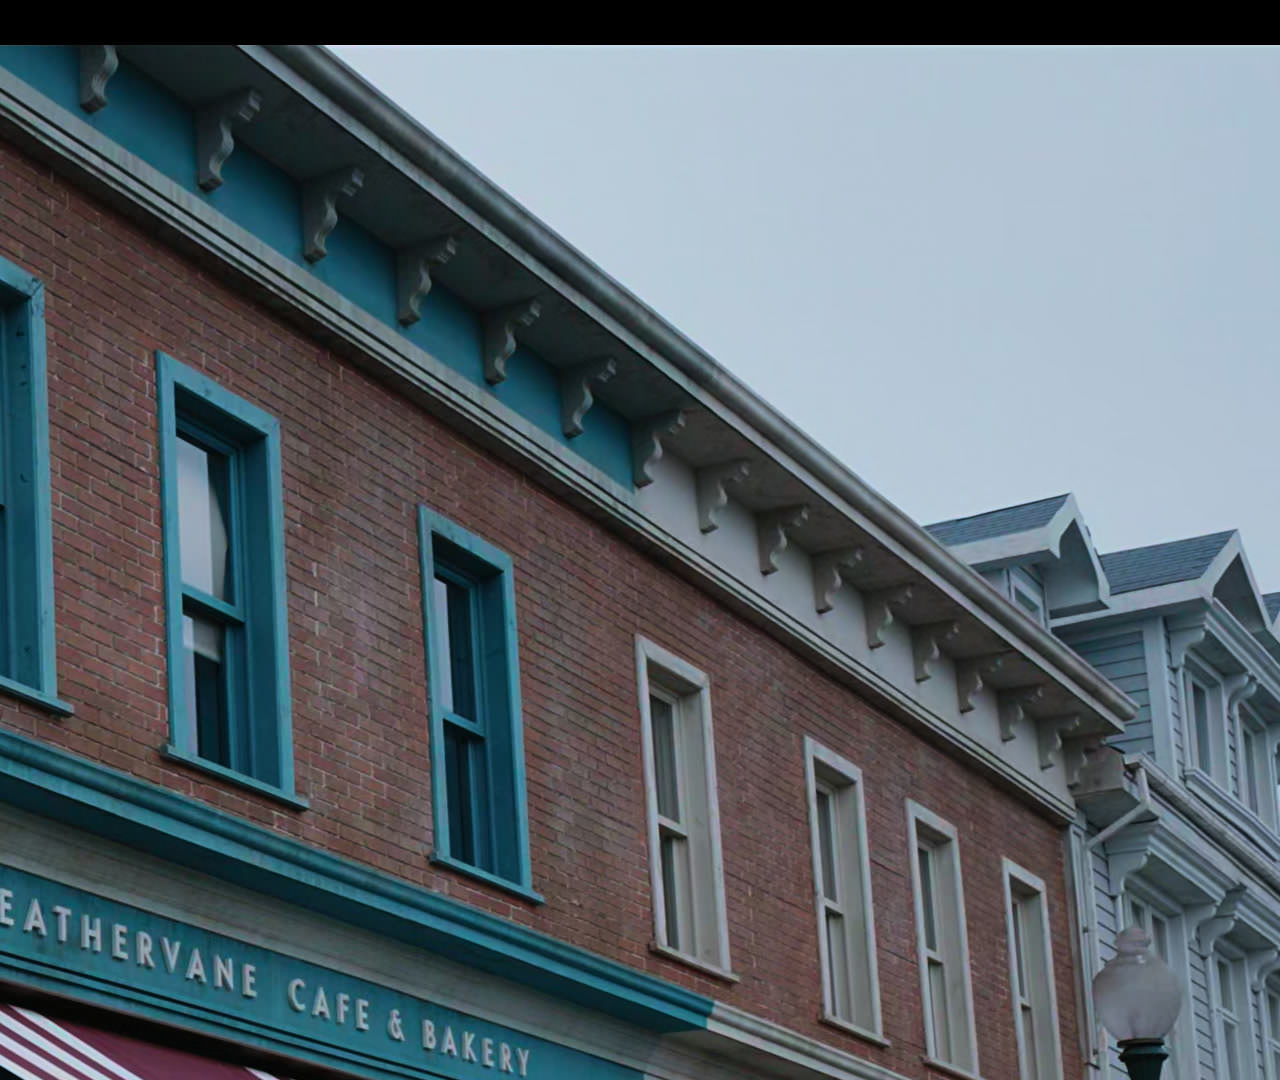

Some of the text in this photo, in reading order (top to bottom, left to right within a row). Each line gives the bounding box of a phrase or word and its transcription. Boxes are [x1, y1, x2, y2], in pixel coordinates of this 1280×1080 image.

[288, 978, 370, 1031] CAFE
[387, 1009, 405, 1041] &
[422, 1019, 529, 1077] BAKERY
